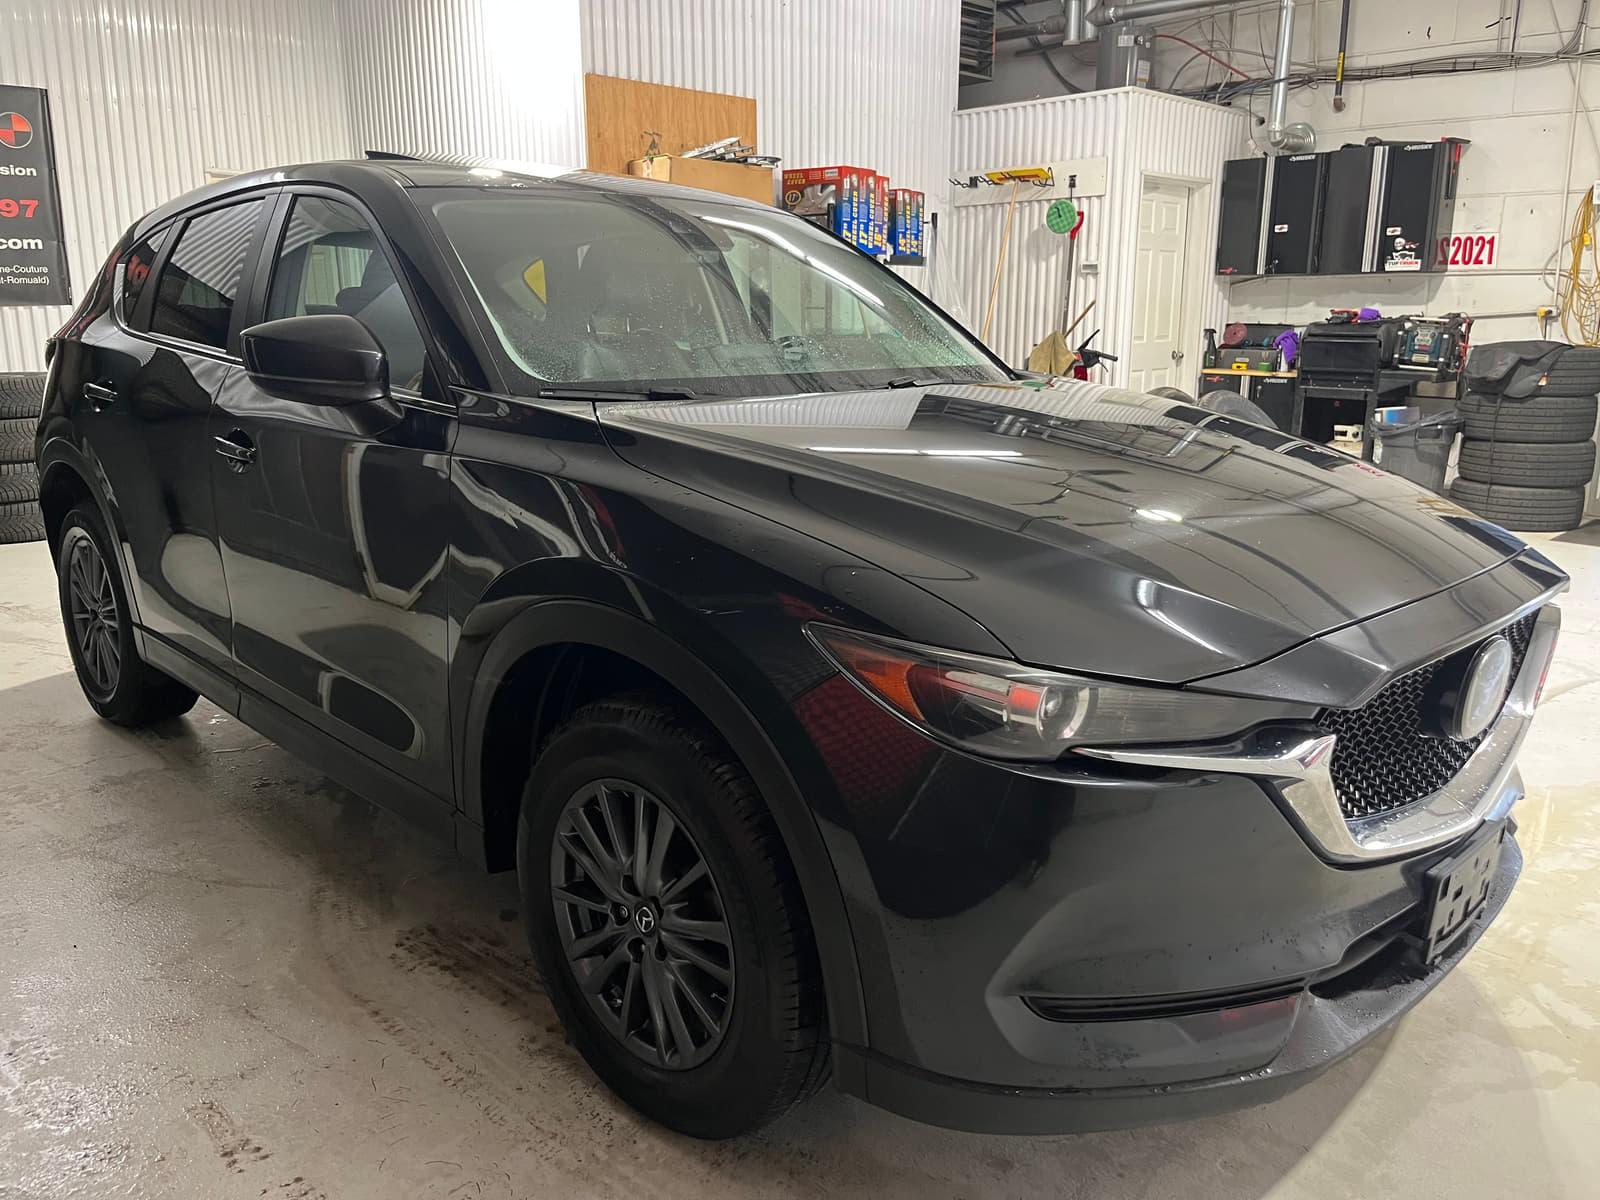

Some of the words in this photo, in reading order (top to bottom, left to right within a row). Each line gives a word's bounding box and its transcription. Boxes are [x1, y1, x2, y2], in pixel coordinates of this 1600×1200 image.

[0, 198, 39, 218] 97
[1449, 235, 1495, 265] 2021
[0, 275, 50, 286] t-Romuald)
